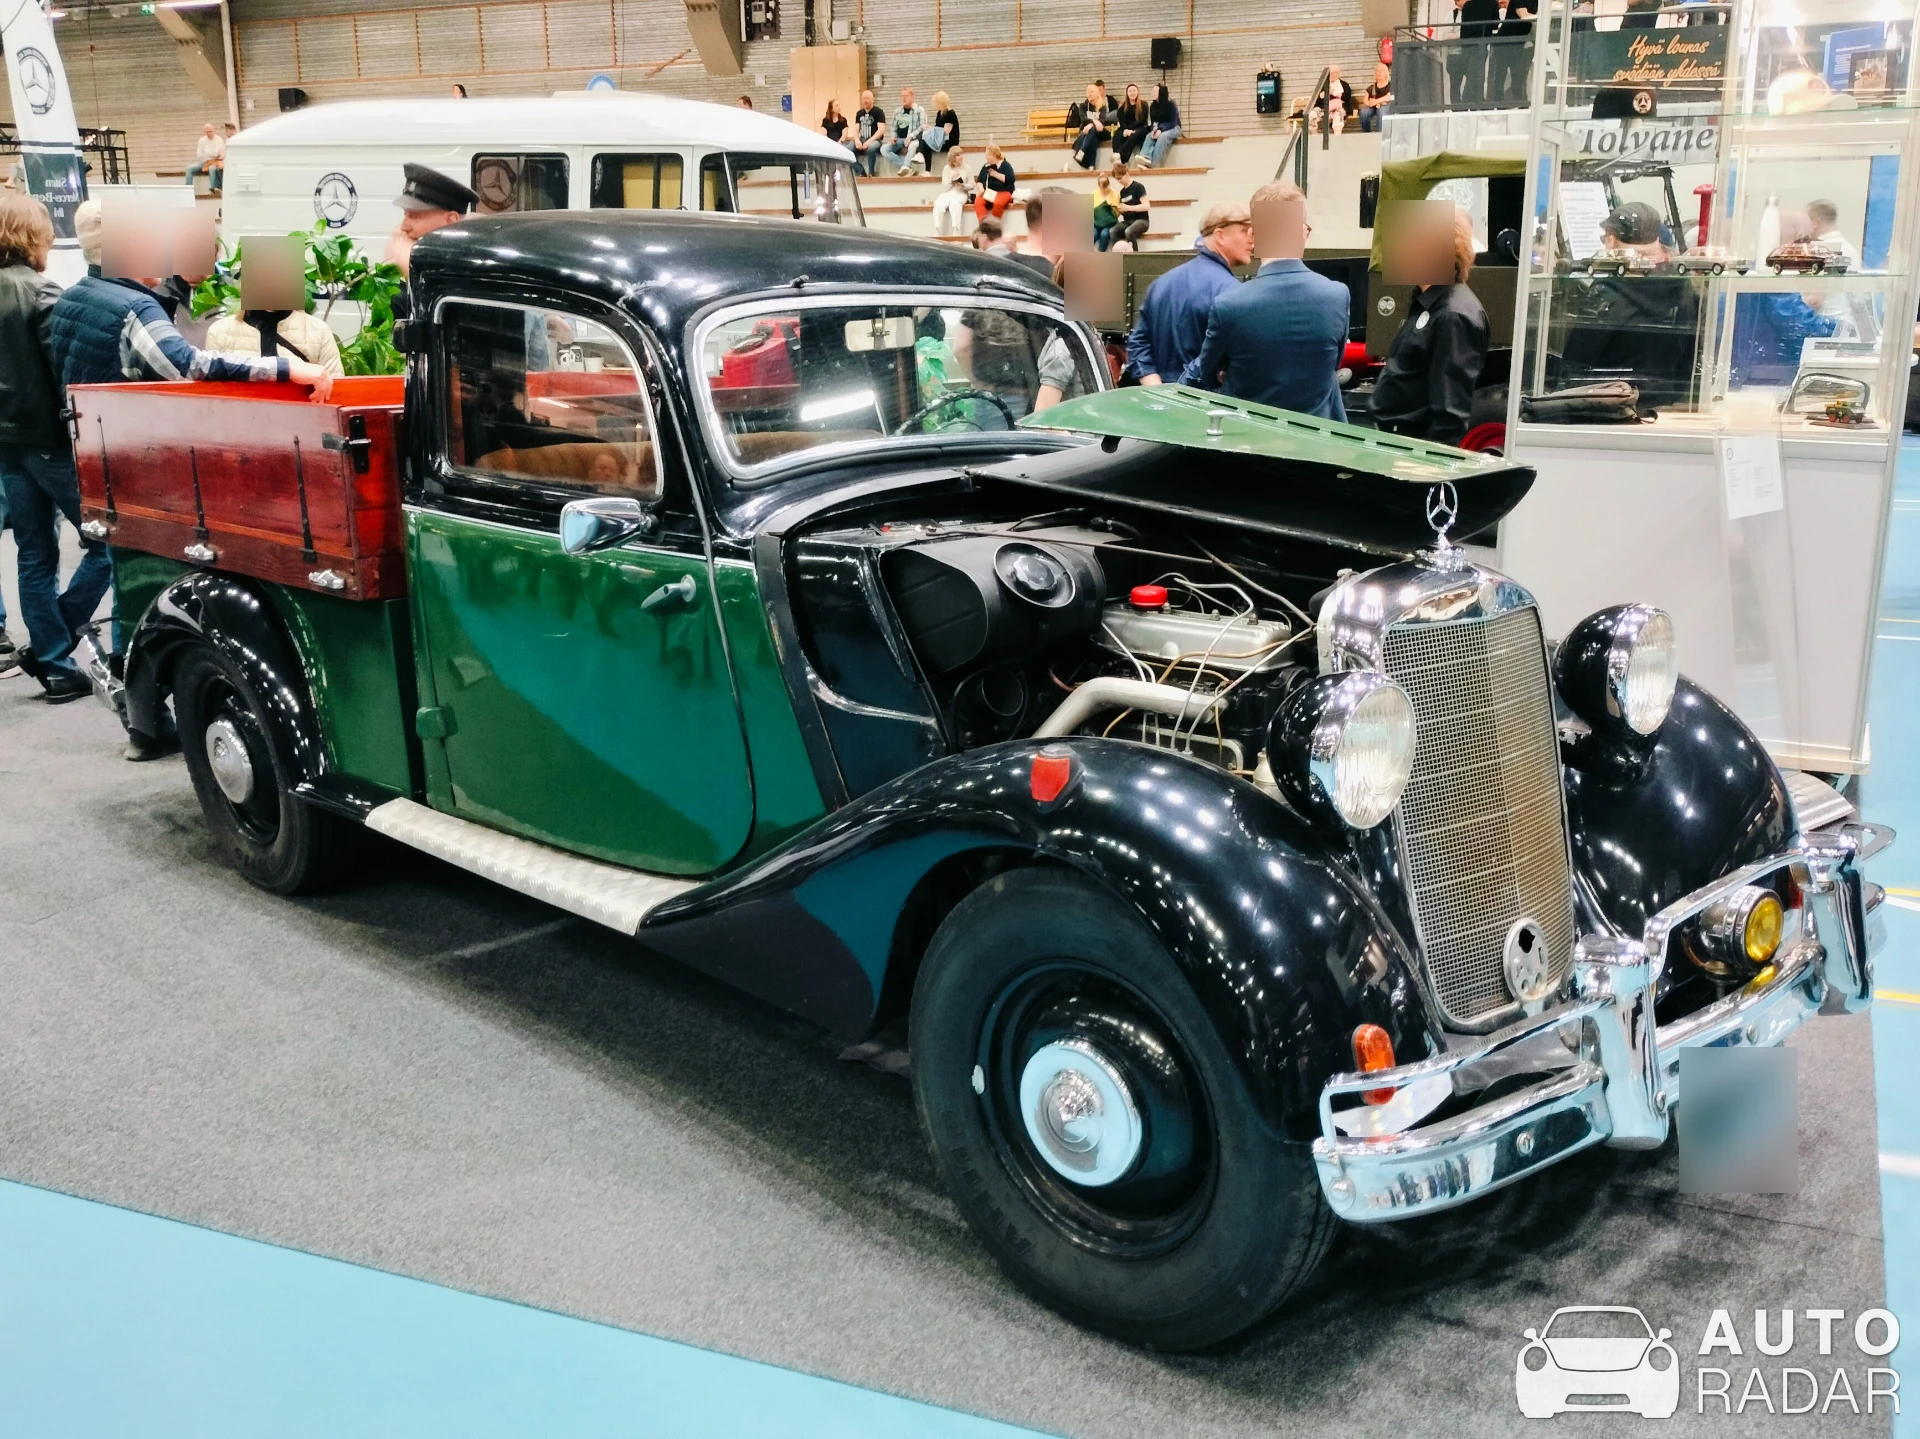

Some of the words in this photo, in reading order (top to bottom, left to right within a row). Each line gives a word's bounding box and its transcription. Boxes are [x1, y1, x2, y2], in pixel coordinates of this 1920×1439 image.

[1626, 33, 1666, 65] Hyvä
[1666, 34, 1710, 55] lounas
[1663, 58, 1721, 87] yhdessä
